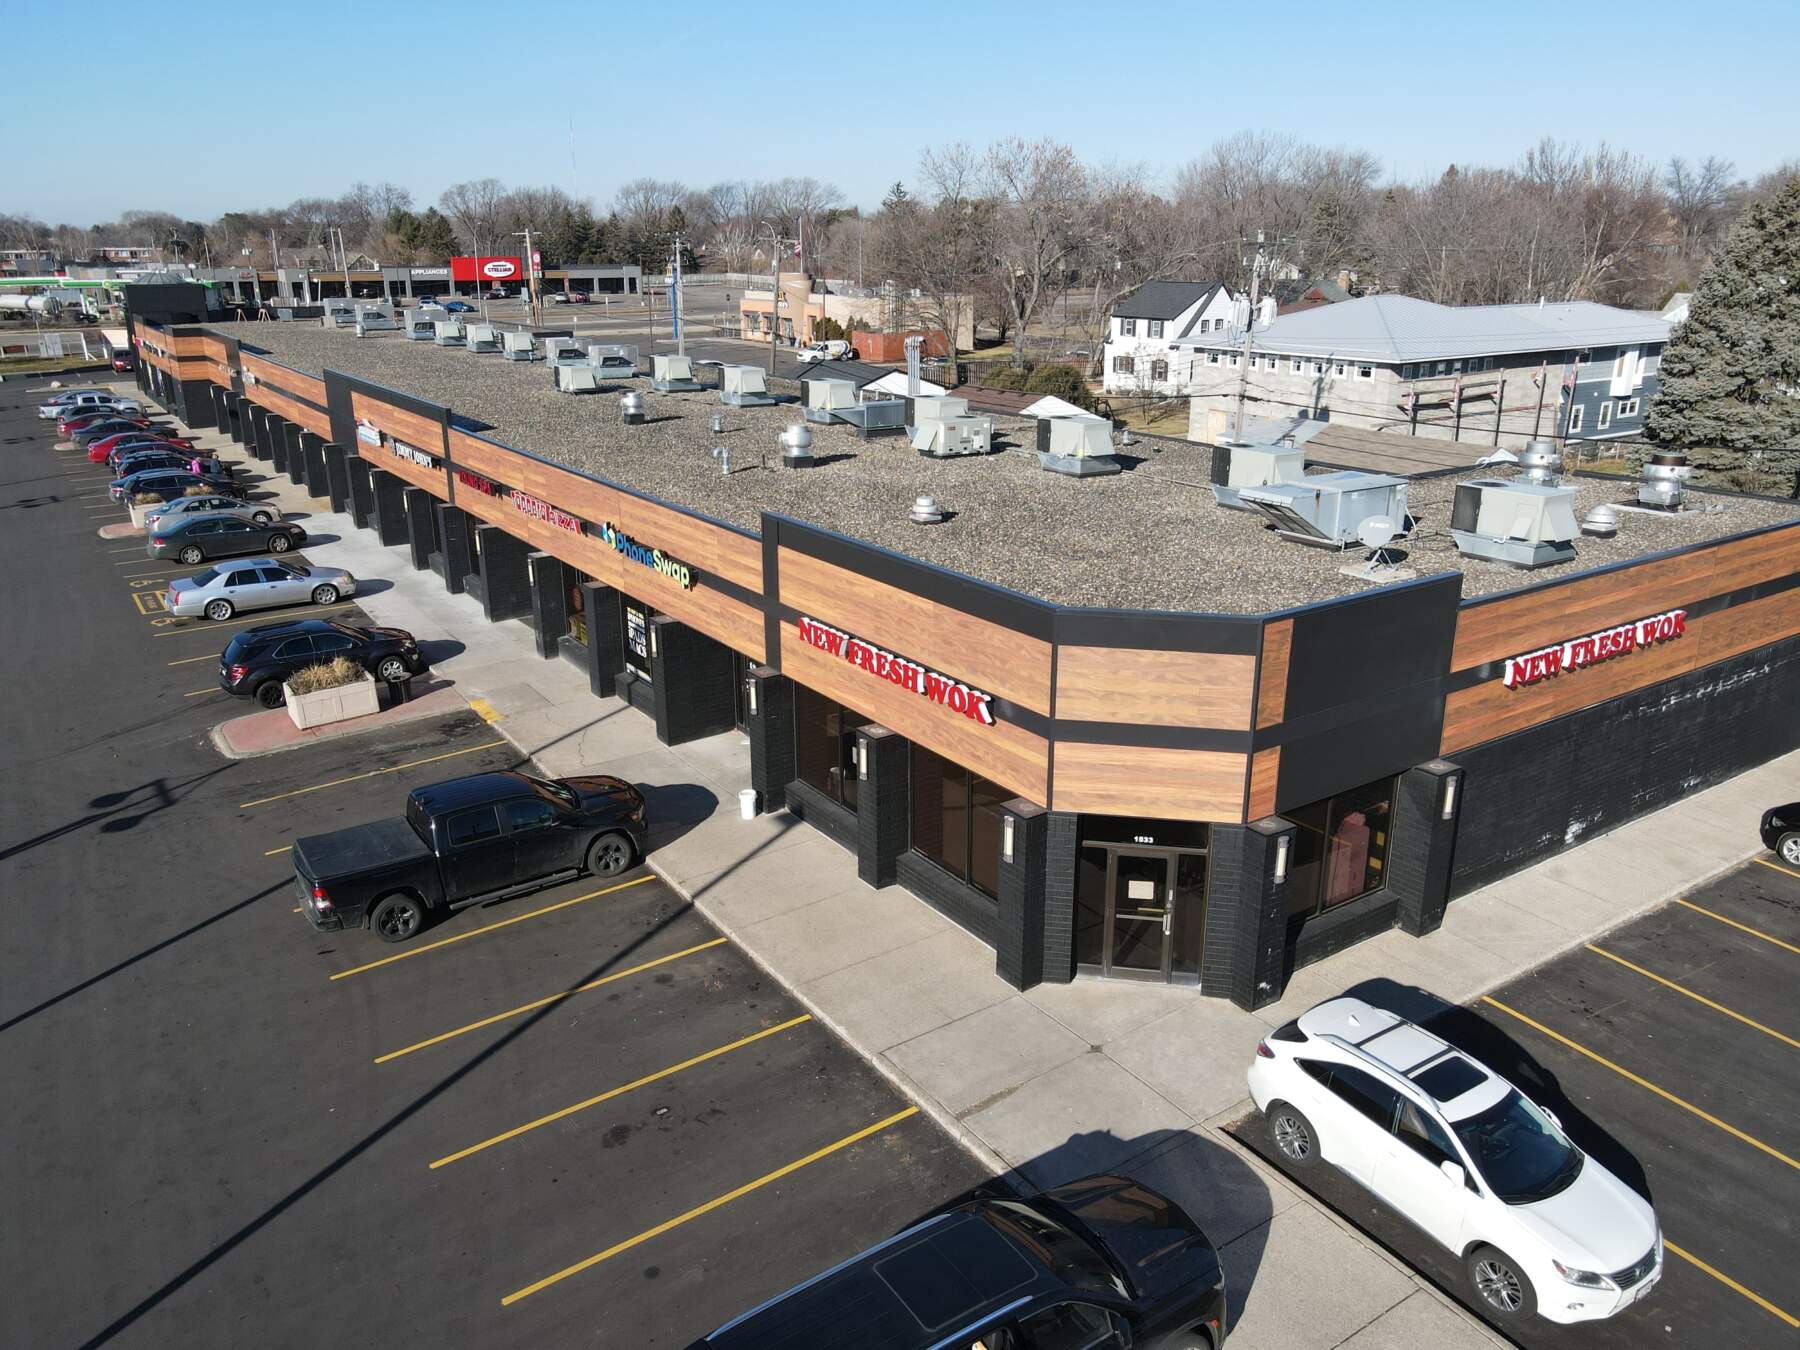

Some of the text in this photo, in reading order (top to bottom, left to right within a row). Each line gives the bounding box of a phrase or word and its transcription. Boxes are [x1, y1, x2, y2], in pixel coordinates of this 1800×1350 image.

[550, 508, 581, 534] PIZZA
[616, 532, 690, 589] PhoneSwap
[799, 617, 992, 724] NEW FRESH WOK
[1505, 610, 1687, 687] NEW FRESH WOK
